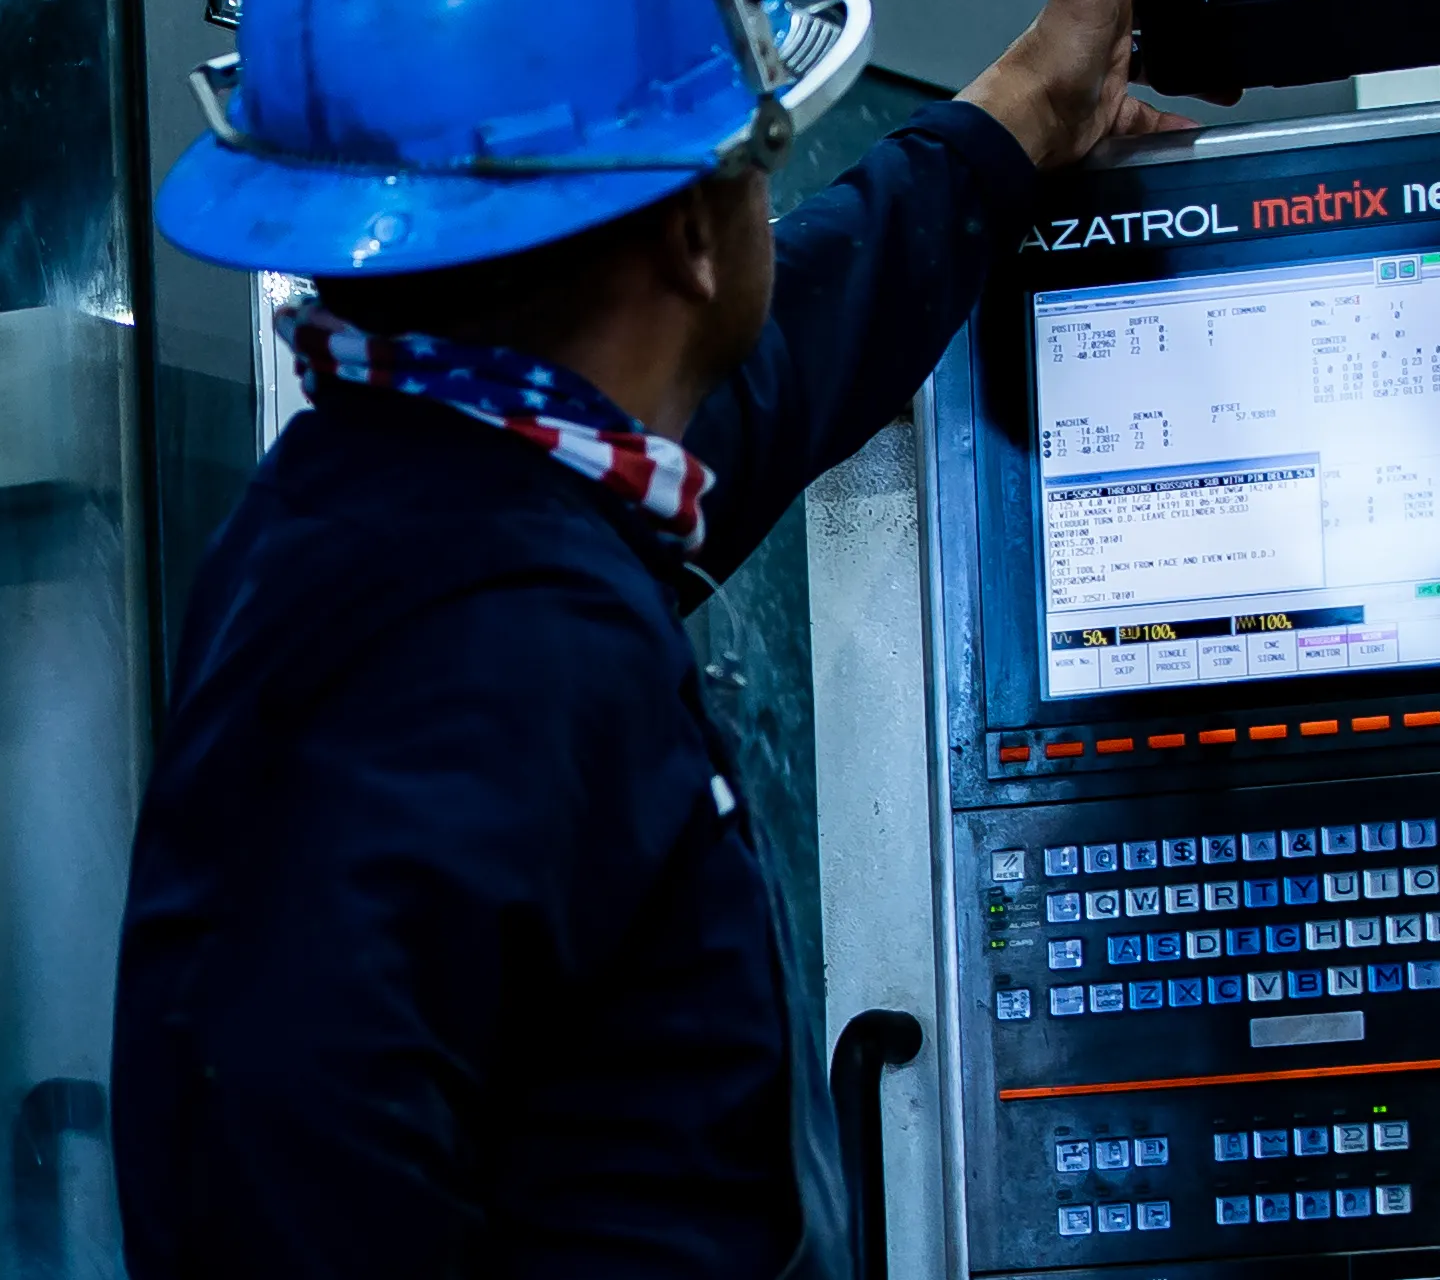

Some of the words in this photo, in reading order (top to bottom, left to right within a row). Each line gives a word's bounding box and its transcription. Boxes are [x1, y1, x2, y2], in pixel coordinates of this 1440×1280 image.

[1017, 203, 1239, 254] AZATROL
[1251, 180, 1389, 230] matrix
[1206, 308, 1226, 318] NEXT
[1230, 304, 1267, 316] COMMAND
[1128, 314, 1160, 326] BUFFER
[1050, 321, 1092, 334] POSITION
[1210, 402, 1241, 413] OFFSET
[1132, 409, 1163, 421] REMAIN
[1055, 416, 1089, 428] MACHINE
[1305, 647, 1341, 659] MONITOR
[1094, 893, 1117, 916] Q
[1131, 890, 1158, 912] W
[1175, 887, 1193, 907] E
[1214, 885, 1234, 906] R
[1254, 882, 1274, 902] T
[1293, 878, 1313, 898] Y
[1333, 875, 1353, 895] U
[1413, 868, 1434, 889] O
[1117, 938, 1138, 959] A
[1156, 936, 1178, 956] S
[1196, 934, 1216, 954] D
[1236, 930, 1253, 949] F
[1275, 926, 1296, 948] G
[1315, 923, 1336, 944] H
[1357, 920, 1374, 941] J
[1395, 917, 1415, 938] K
[1139, 984, 1157, 1004] Z
[1177, 981, 1201, 1003] X
[1217, 979, 1237, 999] C
[1257, 976, 1278, 995] V
[1297, 972, 1317, 992] B
[1337, 969, 1358, 989] N
[1376, 966, 1400, 986] M
